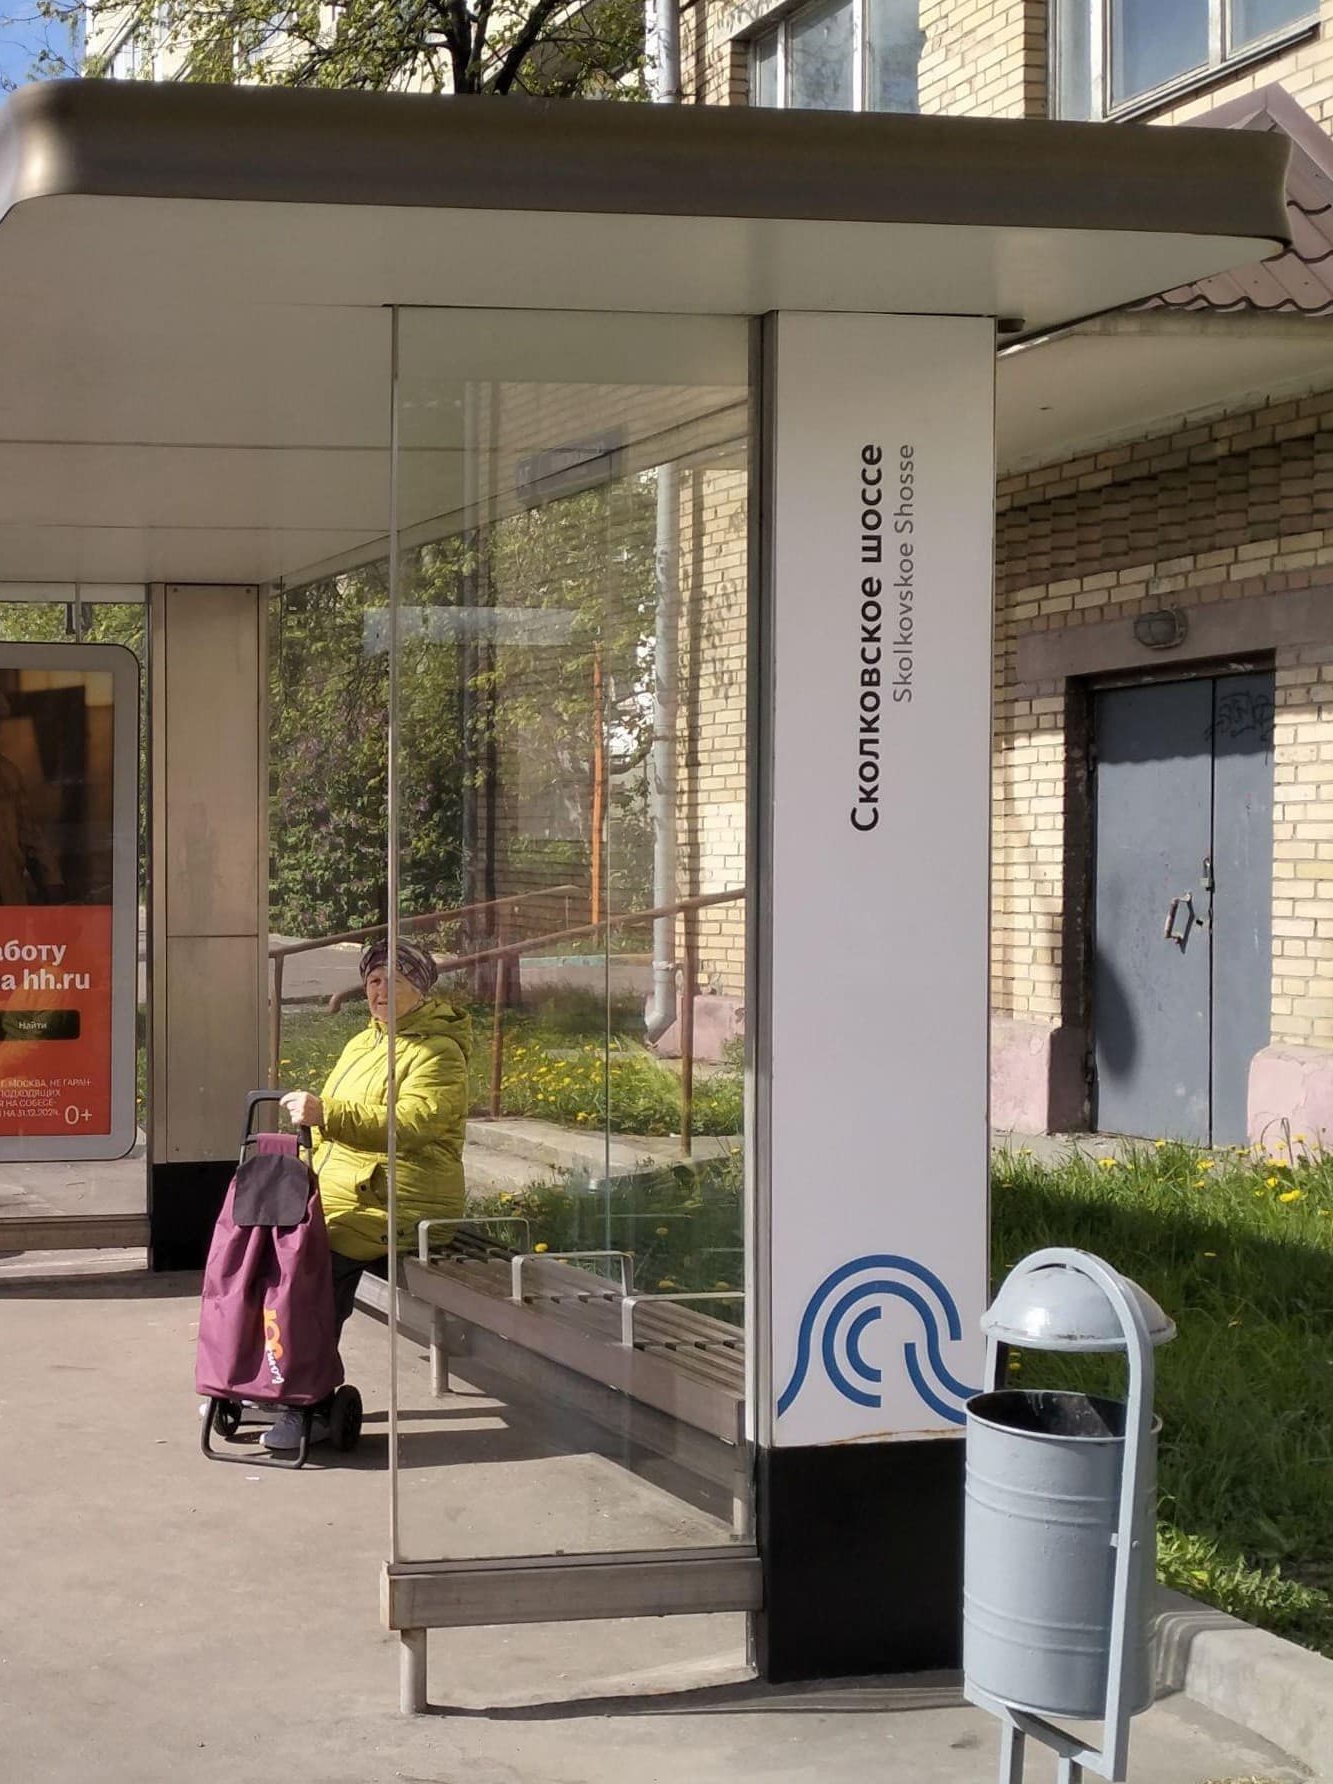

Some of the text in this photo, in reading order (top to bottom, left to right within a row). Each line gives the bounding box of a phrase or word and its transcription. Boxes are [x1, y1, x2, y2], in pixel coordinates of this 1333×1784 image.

[892, 444, 914, 702] Skolkovskoe Shosse
[851, 444, 882, 831] Сколковское шоссе
[23, 968, 90, 991] hh.ru
[18, 1020, 48, 1030] Найти
[65, 1105, 92, 1125] 0+
